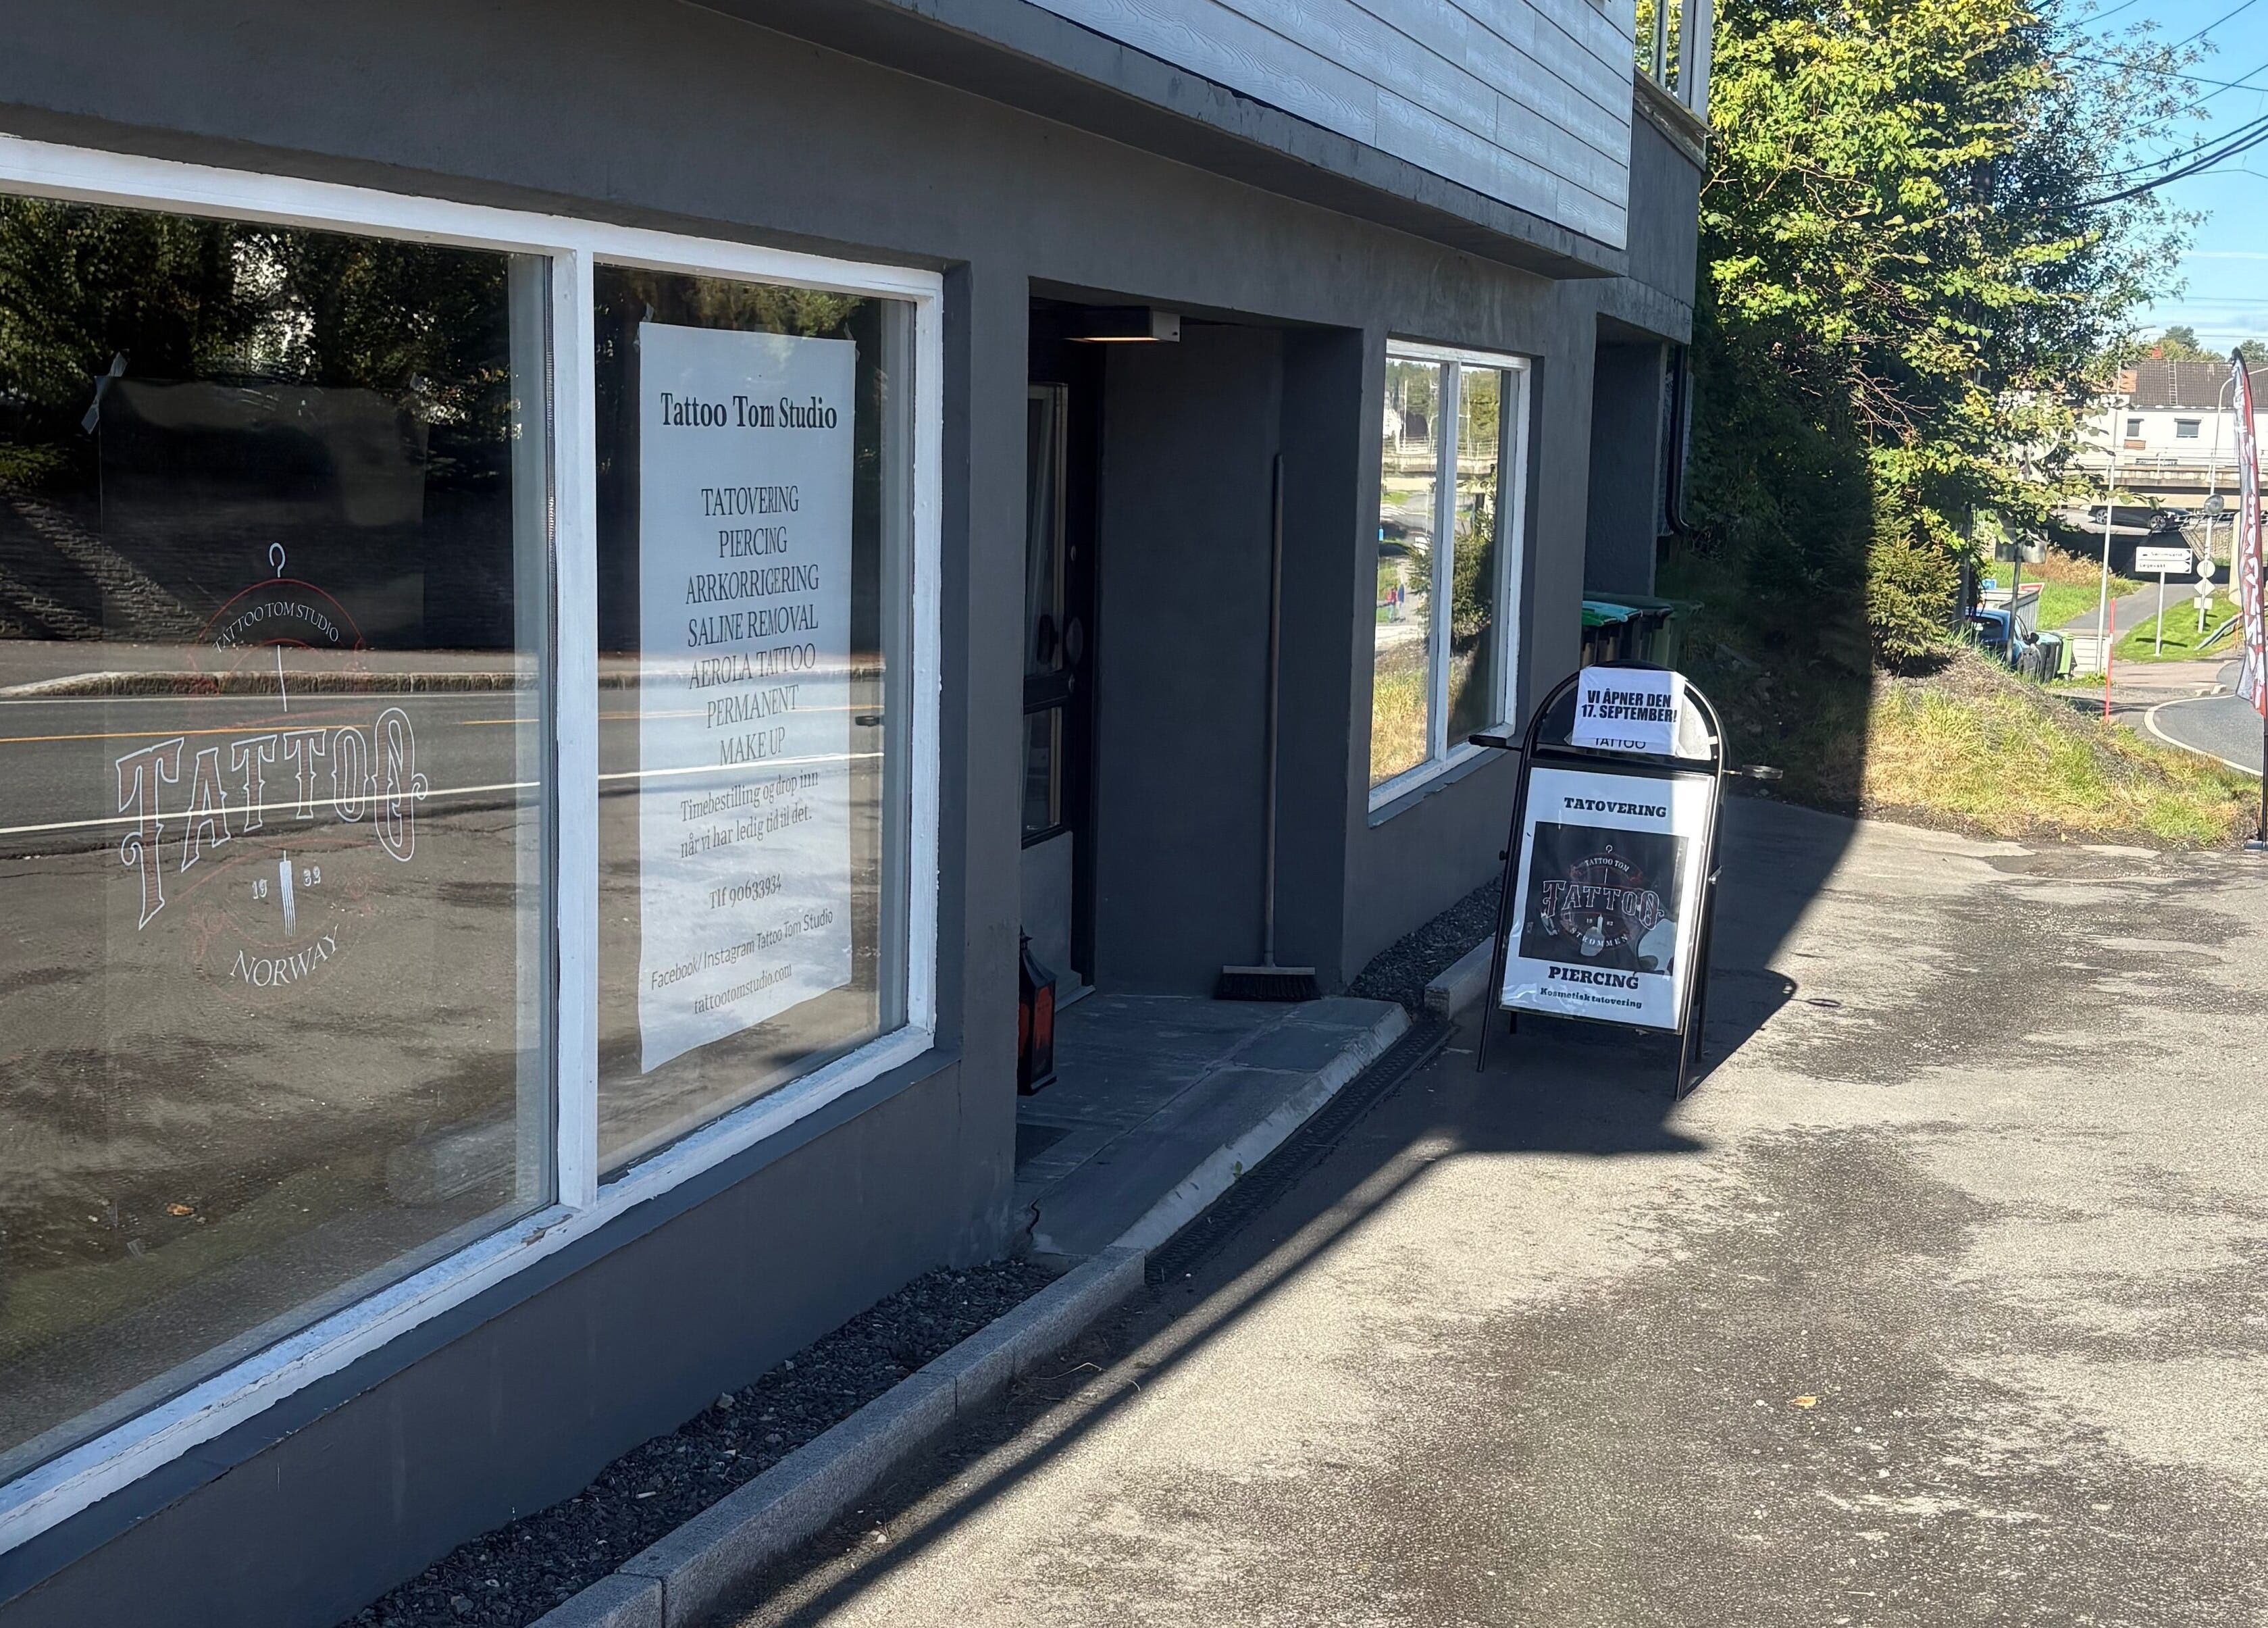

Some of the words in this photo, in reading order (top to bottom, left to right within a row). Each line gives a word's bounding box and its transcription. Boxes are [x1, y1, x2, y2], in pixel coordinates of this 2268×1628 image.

[661, 392, 727, 427] Tattoo
[733, 396, 775, 427] Tom
[779, 397, 837, 429] Studio
[702, 486, 799, 516] TATOVERING
[719, 527, 787, 558] PIERCING
[685, 564, 819, 604] ARRKORRIGERING
[213, 607, 263, 653] TATTOO
[265, 602, 295, 616] TOM
[297, 604, 338, 642] STUDIO
[688, 613, 743, 647] SALINE
[747, 605, 819, 638] REMOVAL
[689, 655, 751, 689] AEROLA
[756, 643, 816, 679] TATTOO
[707, 684, 799, 728] PERMANENT
[1581, 705, 1596, 717] 17.
[1599, 705, 1677, 722] SEPTEMBER!
[1587, 690, 1601, 703] VI
[1603, 688, 1643, 706] ÅPNER
[1647, 693, 1672, 707] DEN
[720, 732, 766, 765] MAKE
[770, 727, 785, 755] UP
[681, 784, 761, 822] Timebestilling
[763, 782, 774, 803] og
[776, 774, 797, 796] drop
[800, 770, 818, 788] inn
[1564, 797, 1666, 817] TATOVERING
[115, 707, 428, 930] TATTOO
[681, 832, 700, 858] når
[702, 829, 711, 850] vi
[713, 825, 733, 847] har
[736, 816, 764, 841] ledig
[767, 809, 777, 832] tid
[780, 805, 789, 828] til
[792, 803, 812, 824] det.
[1584, 857, 1614, 866] TATTOO
[1614, 860, 1630, 872] TOM
[710, 887, 727, 909] Tlf
[729, 873, 781, 907] 90633934
[1543, 880, 1664, 931] TATTOO
[230, 923, 339, 986] NORWAY
[704, 940, 754, 969] Instagram
[756, 928, 782, 950] Tattoo
[783, 920, 801, 938] Tom
[804, 908, 833, 932] Studio
[694, 964, 792, 1014] tattootomstudio.com
[1548, 966, 1639, 989] PIERCING
[1540, 988, 1591, 1001] Kosmetisk
[1591, 996, 1642, 1009] tatovering
